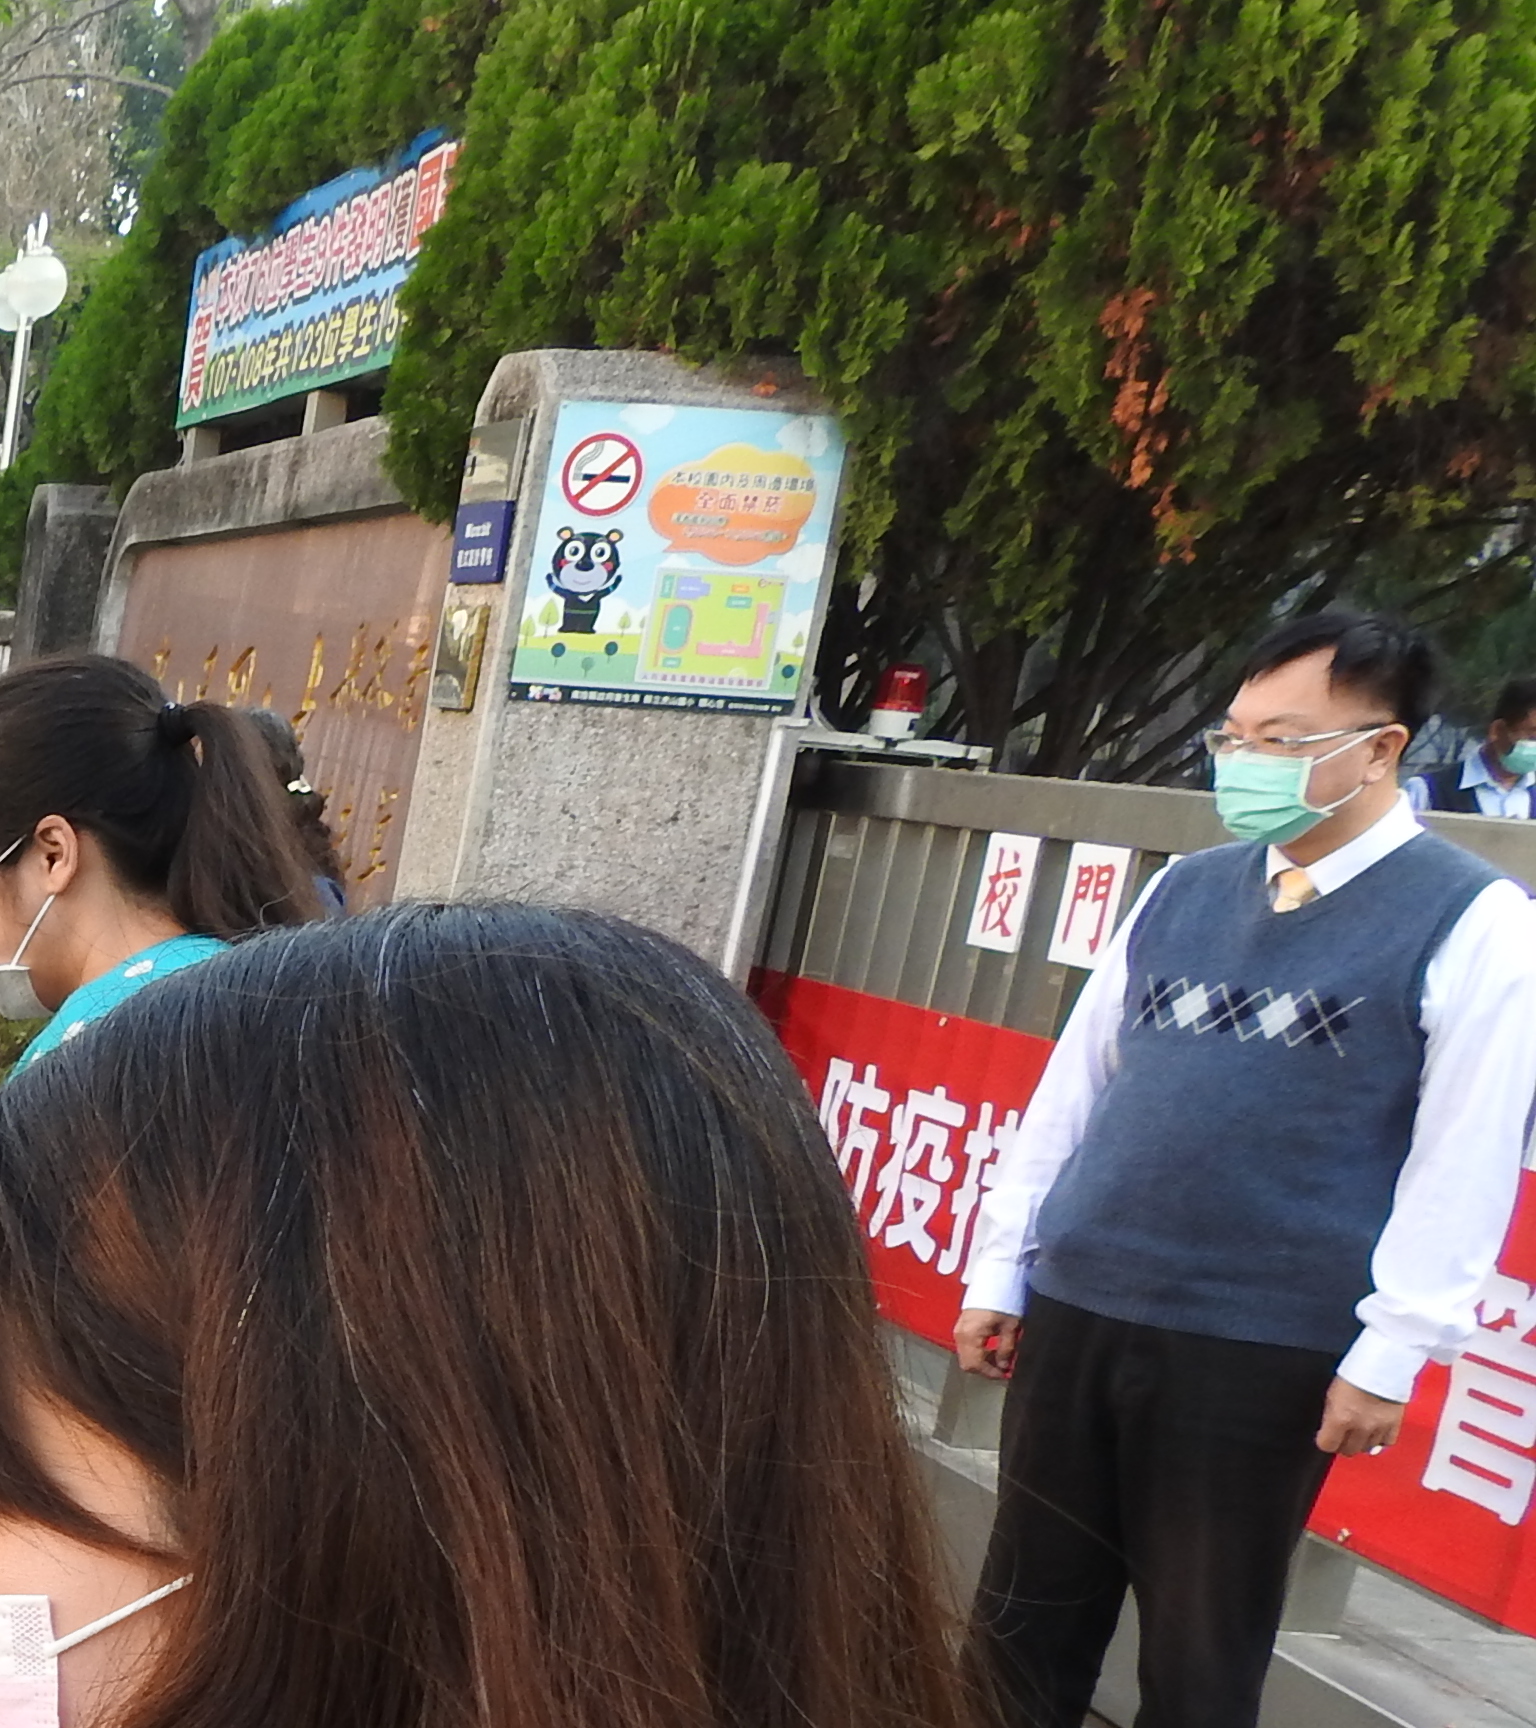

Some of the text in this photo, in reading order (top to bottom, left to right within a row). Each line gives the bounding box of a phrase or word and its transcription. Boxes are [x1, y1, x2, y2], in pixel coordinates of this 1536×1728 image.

[207, 292, 408, 399] 107-108年共123位學生15
